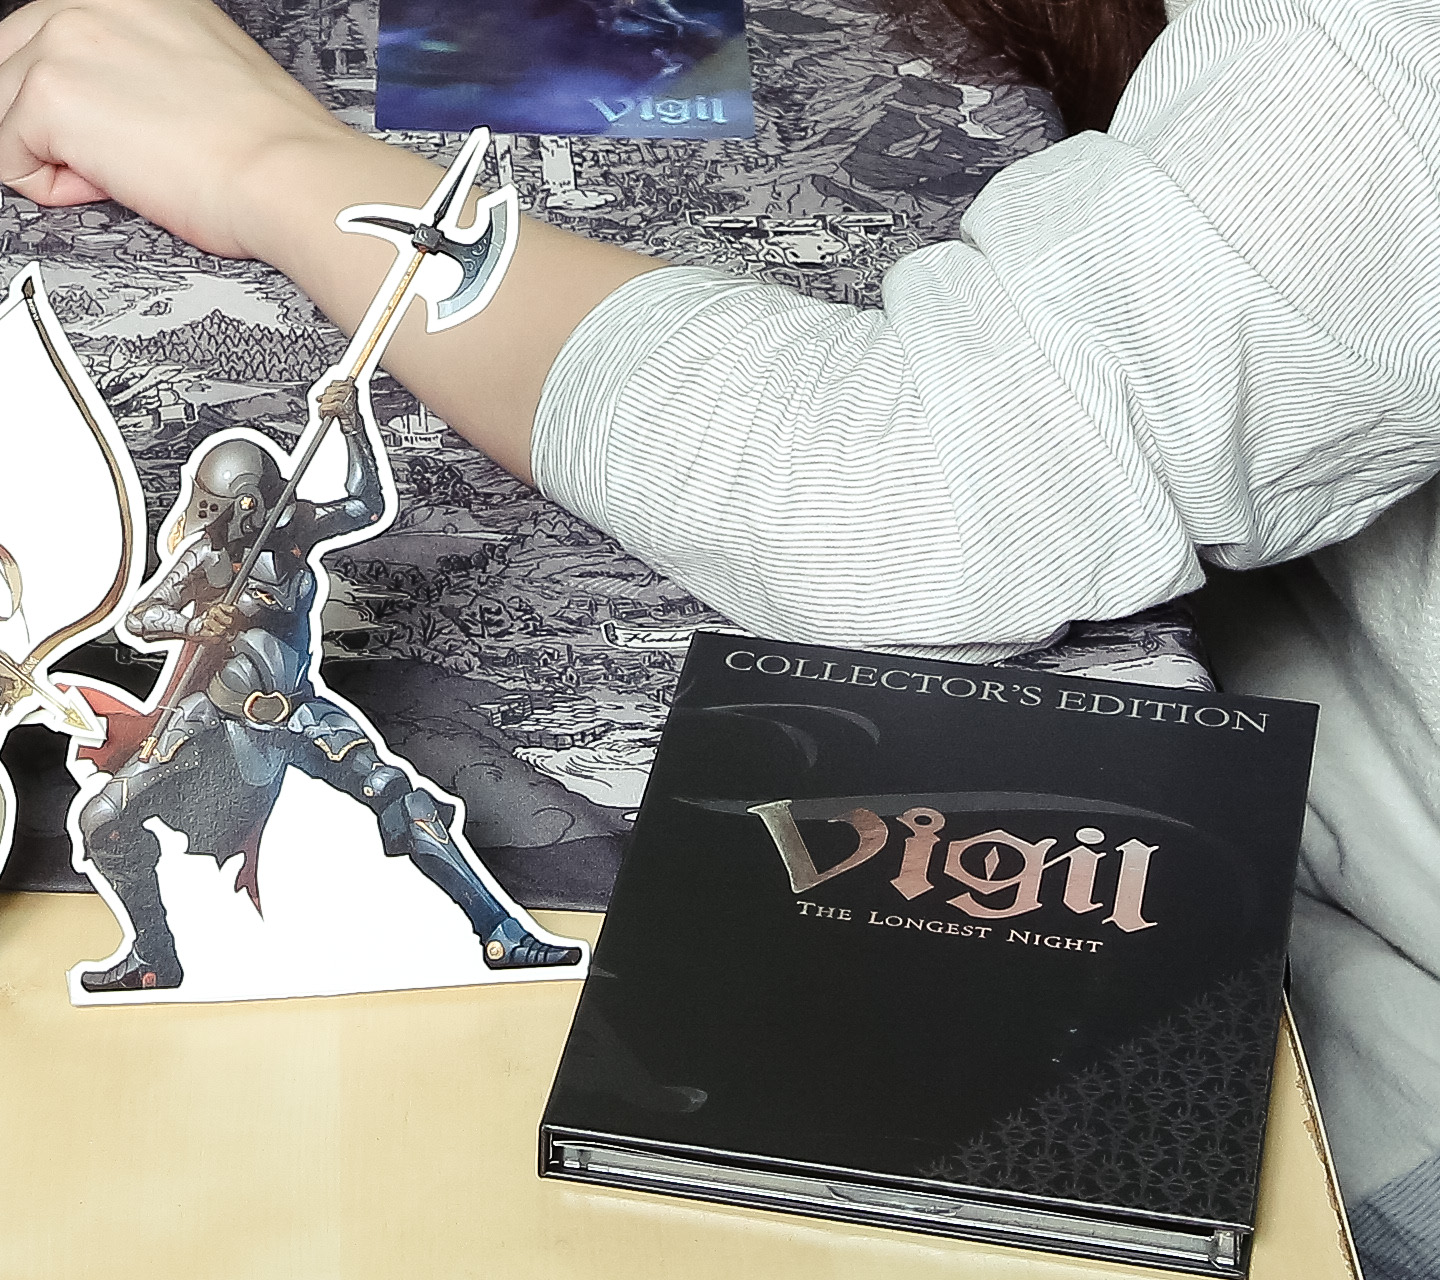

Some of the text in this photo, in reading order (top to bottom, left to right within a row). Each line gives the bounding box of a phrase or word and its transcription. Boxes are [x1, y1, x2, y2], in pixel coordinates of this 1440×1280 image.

[585, 93, 729, 125] Vigil
[723, 649, 1271, 734] COLLECTOR'S EDITION
[746, 799, 1160, 933] Vigil
[796, 899, 1104, 954] THE LONGEST NIGHT
